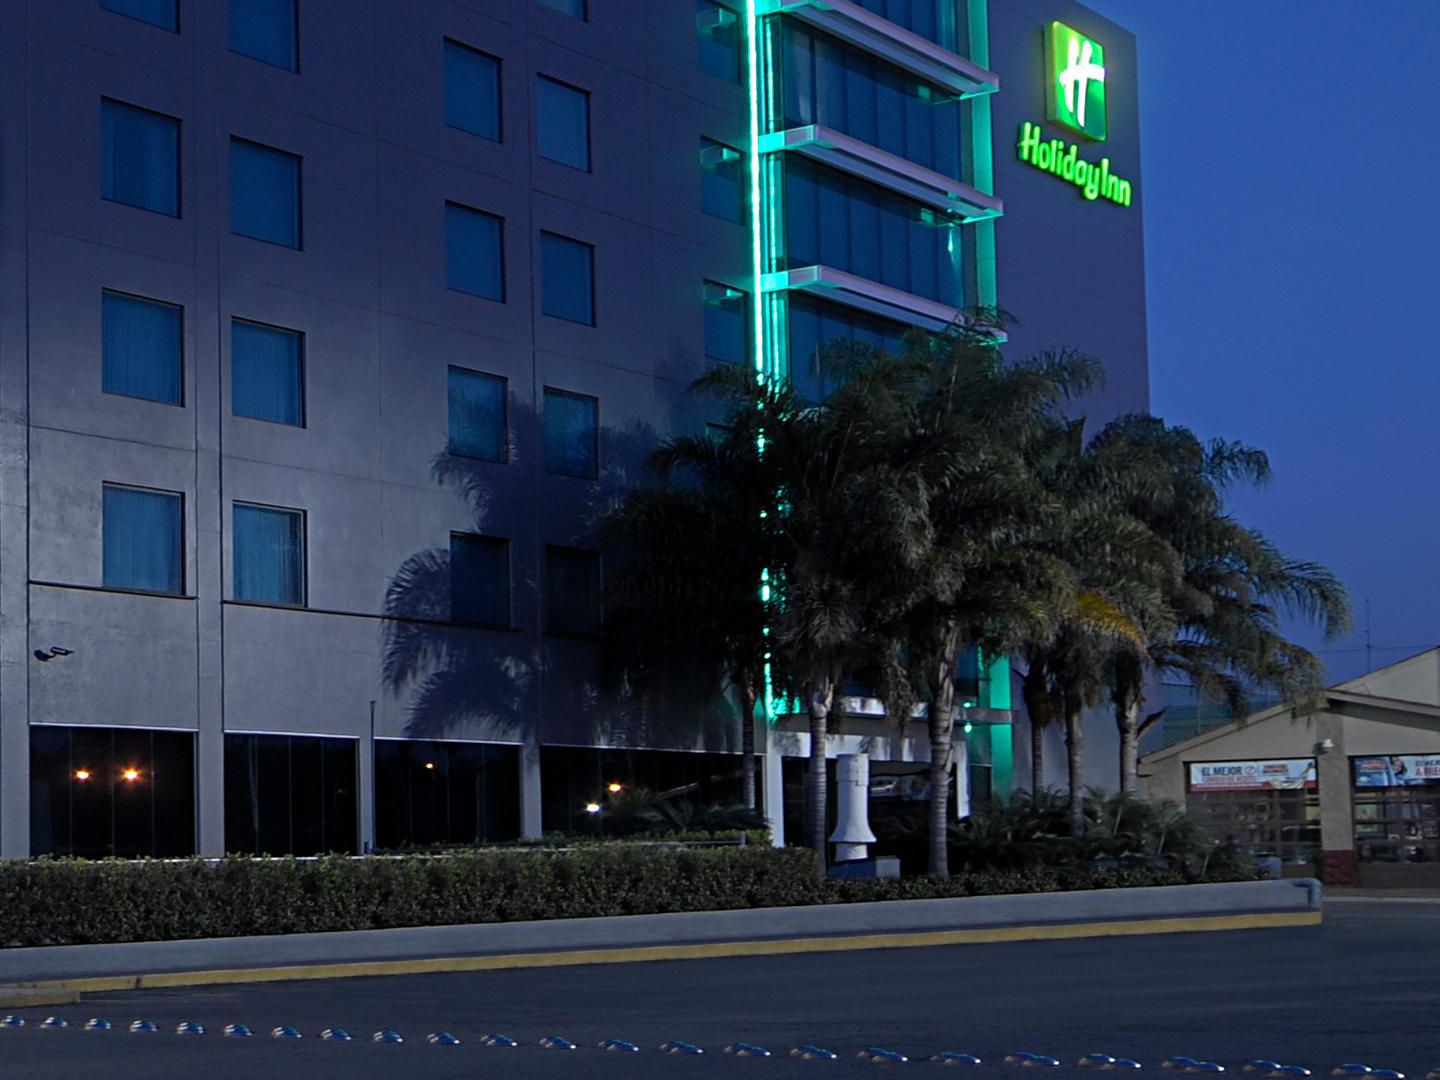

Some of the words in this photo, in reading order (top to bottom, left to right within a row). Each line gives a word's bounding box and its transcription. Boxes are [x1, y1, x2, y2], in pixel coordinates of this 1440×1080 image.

[1059, 38, 1105, 128] H
[1020, 121, 1100, 201] Holiday
[1099, 158, 1132, 208] Inn
[1202, 767, 1211, 776] EL
[1213, 766, 1242, 776] MEJOR
